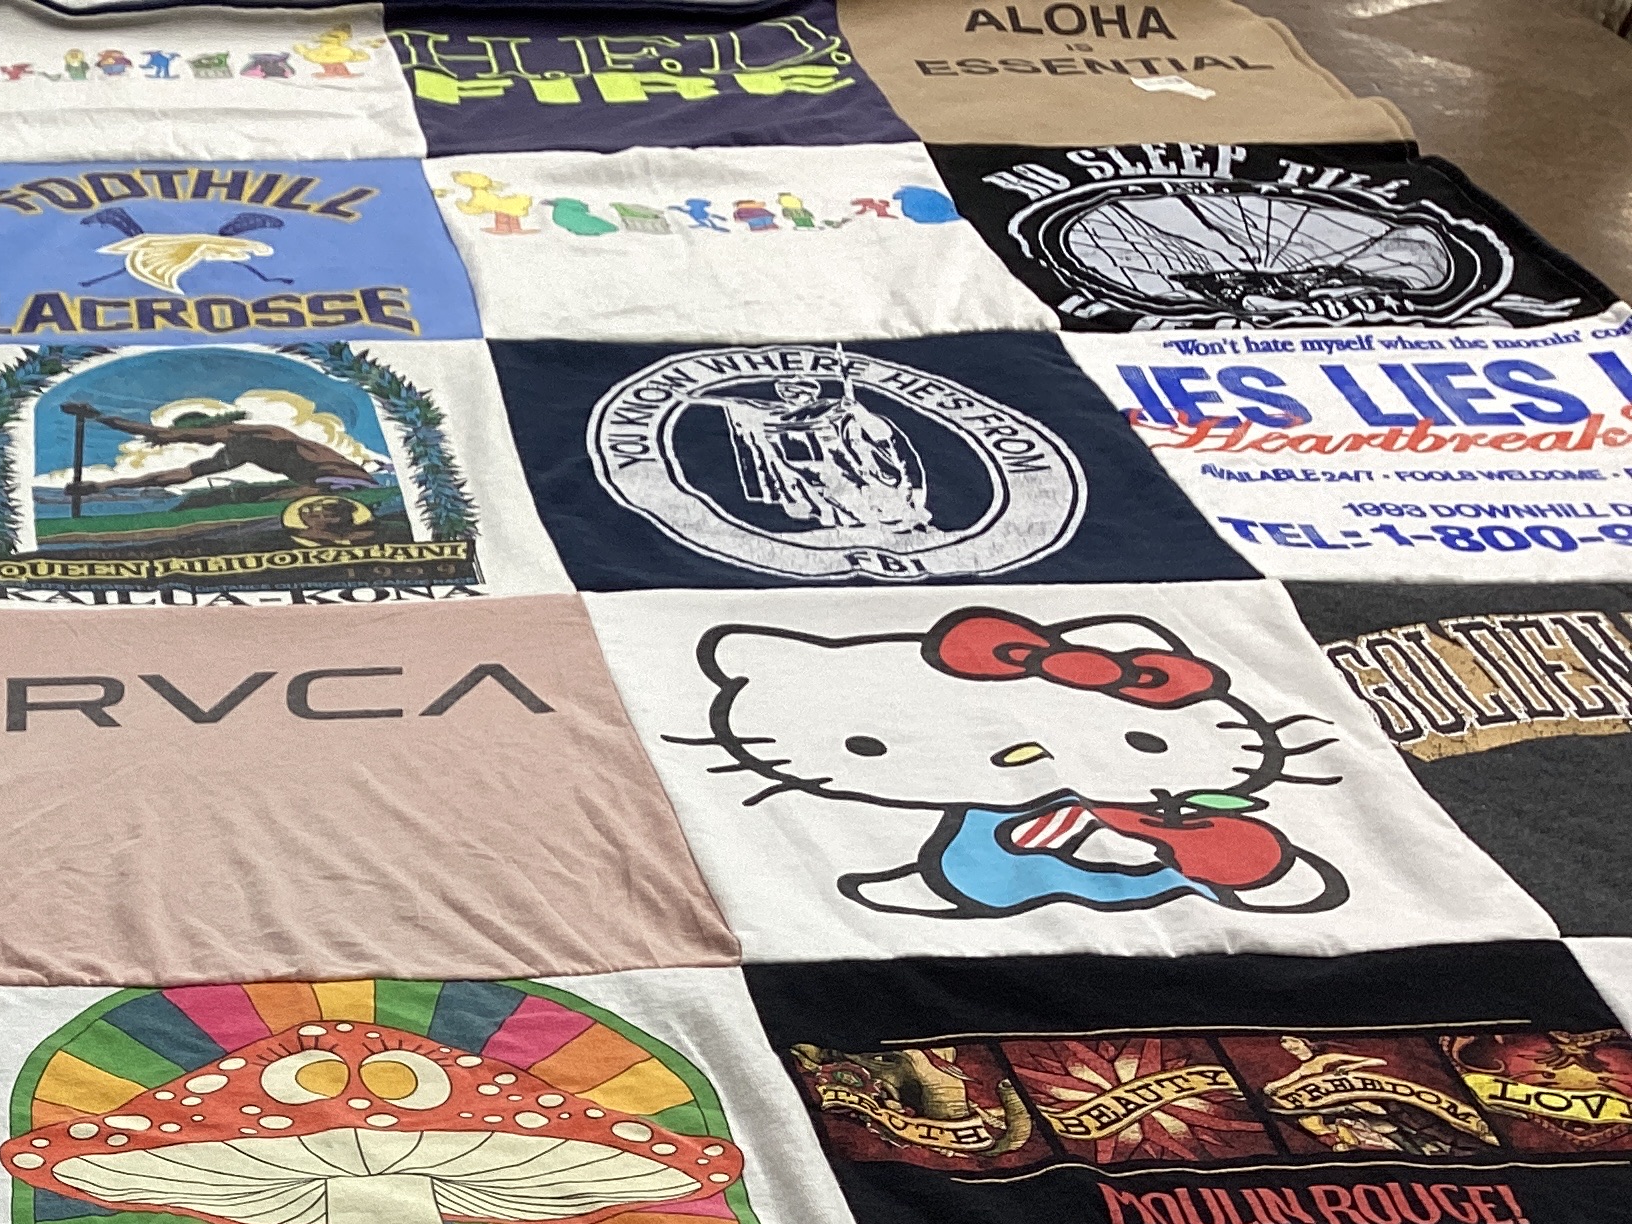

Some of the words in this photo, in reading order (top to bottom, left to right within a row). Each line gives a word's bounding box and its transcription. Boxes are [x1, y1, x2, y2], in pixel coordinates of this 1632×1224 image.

[965, 3, 1177, 40] ALOHA
[914, 55, 1274, 77] ESSENTIAL
[1066, 143, 1249, 180] SLEEP
[1277, 158, 1411, 200] TILL
[695, 351, 869, 377] WHERE
[1244, 335, 1295, 354] hate
[1300, 333, 1375, 355] myself
[1377, 335, 1447, 350] when
[1449, 336, 1488, 349] the
[617, 366, 697, 432] KNOW
[882, 371, 978, 411] HE'S
[1116, 364, 1313, 429] IES
[1319, 359, 1591, 428] LIES
[618, 431, 652, 470] YOU
[962, 408, 1052, 474] FROM
[1200, 462, 1320, 483] AVAILABLE
[1394, 469, 1478, 482] FOOLS
[1342, 502, 1427, 518] 1993
[1428, 502, 1611, 518] DOWNHILL
[844, 551, 926, 573] FBI
[5, 662, 558, 733] RVCA
[1320, 609, 1632, 748] GOLDEN
[821, 1087, 990, 1144] TRUTH
[1055, 1069, 1227, 1136] BEAUTY
[1279, 1076, 1475, 1124] FREEDOM
